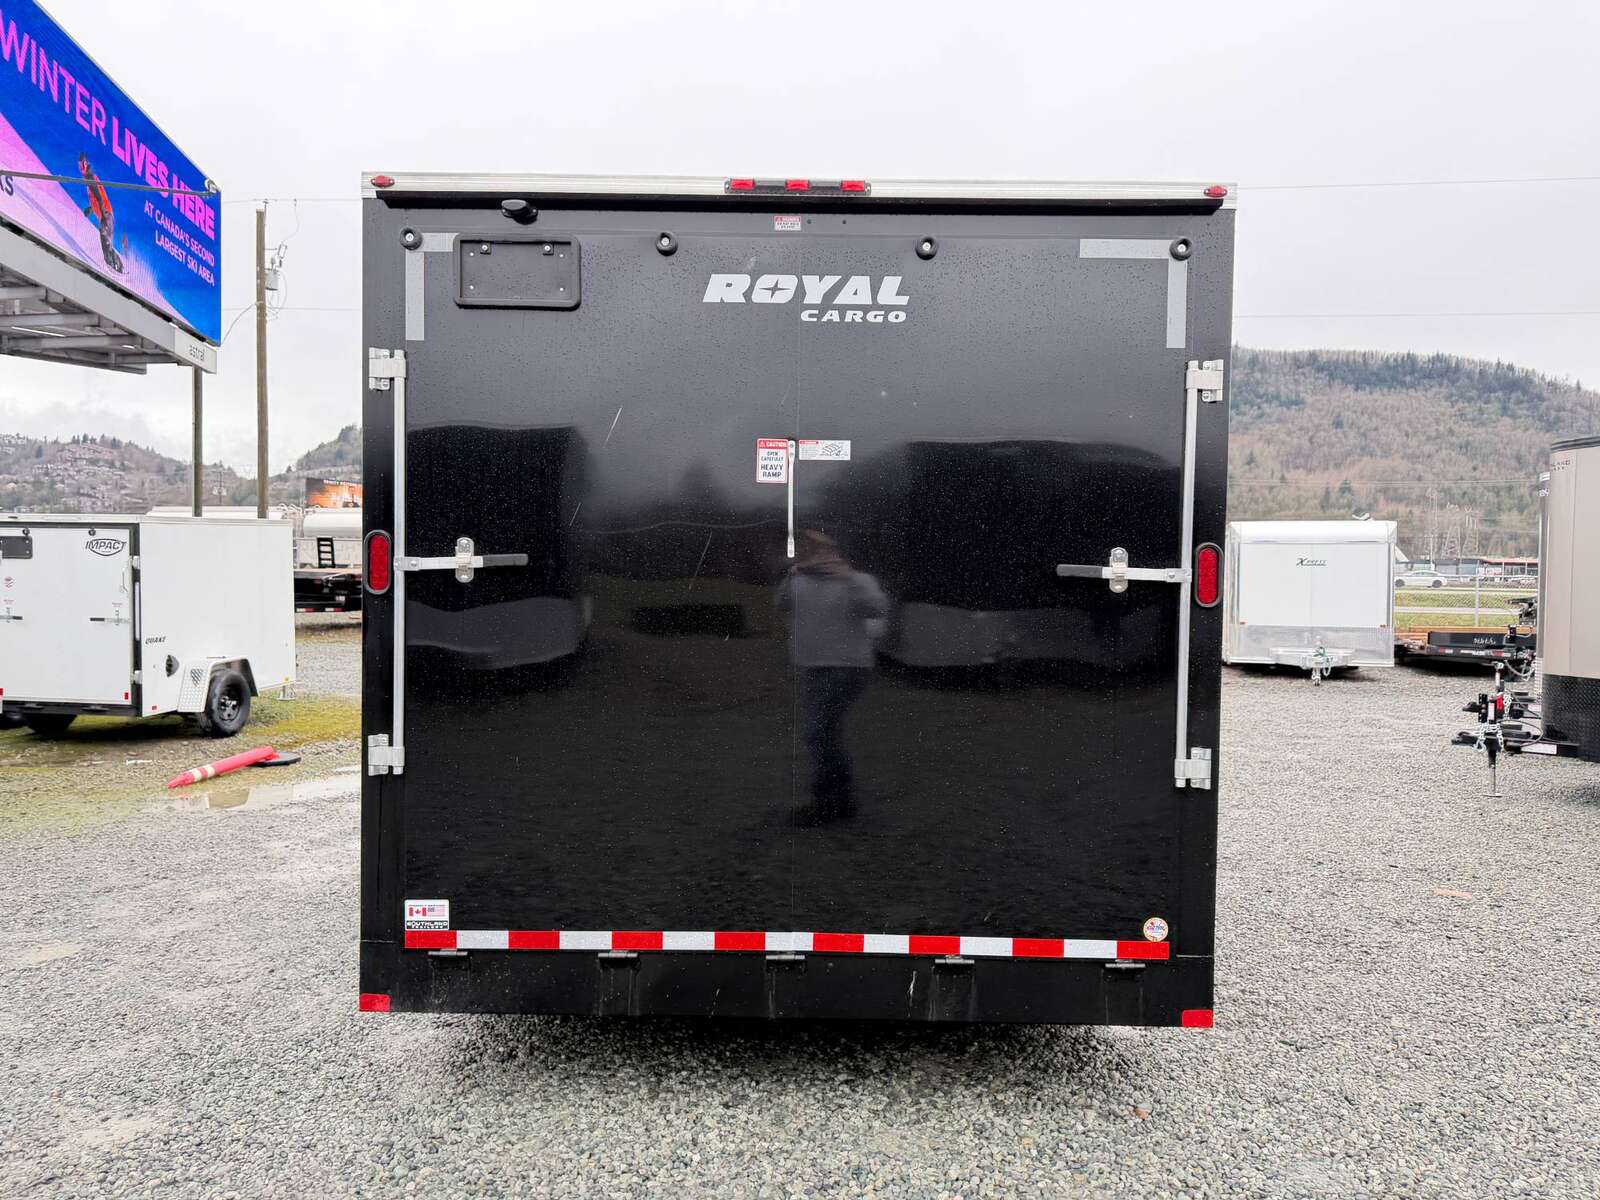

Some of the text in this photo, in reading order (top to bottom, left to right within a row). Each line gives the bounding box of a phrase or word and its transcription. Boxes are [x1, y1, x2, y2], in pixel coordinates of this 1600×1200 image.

[0, 8, 215, 240] WINTER LIVES HERE
[144, 200, 215, 268] AT CANADA'S SECOND
[155, 229, 215, 287] LARGEST SKI AREA
[702, 273, 910, 305] ROYAL
[800, 309, 907, 323] CARGO
[760, 463, 784, 471] HEAVY
[85, 540, 127, 550] IMPACT
